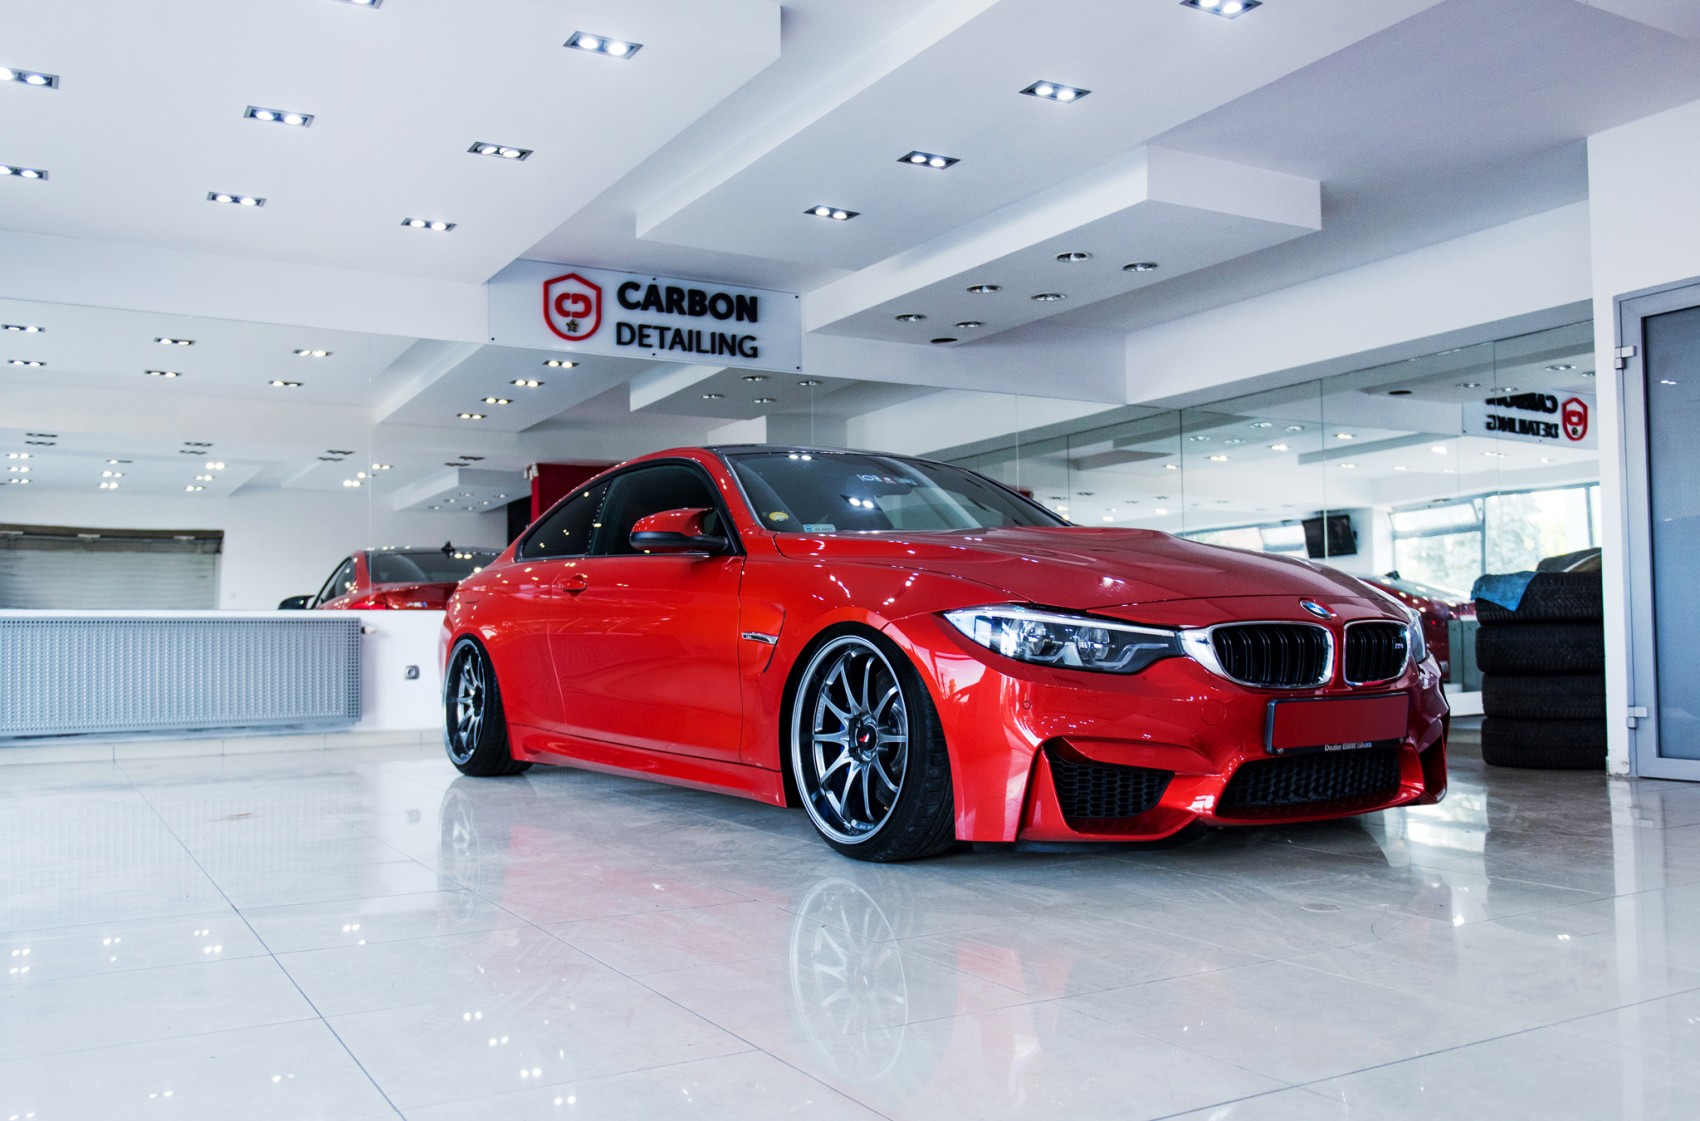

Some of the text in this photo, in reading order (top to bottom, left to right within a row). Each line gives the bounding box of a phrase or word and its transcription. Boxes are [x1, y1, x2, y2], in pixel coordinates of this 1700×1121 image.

[617, 281, 758, 322] CARBON
[616, 321, 758, 358] DETAILING
[1324, 744, 1342, 752] Dealer
[1342, 742, 1356, 750] BMW
